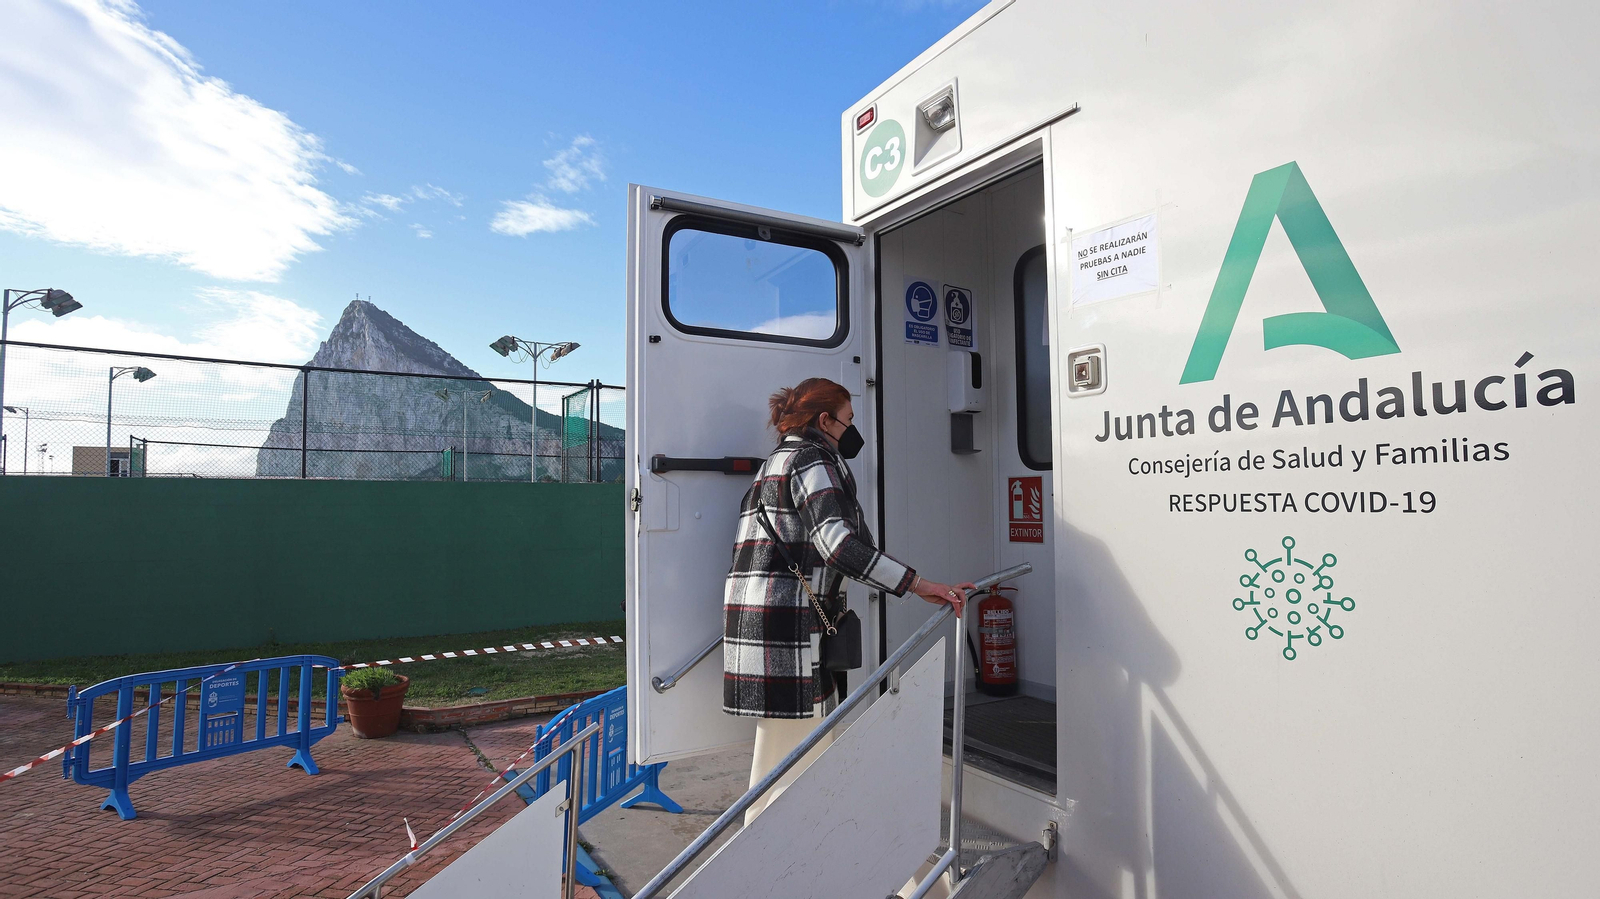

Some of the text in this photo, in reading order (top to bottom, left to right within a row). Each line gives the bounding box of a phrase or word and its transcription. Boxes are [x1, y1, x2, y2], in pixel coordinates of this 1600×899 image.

[864, 136, 901, 180] C3
[1077, 232, 1148, 259] NO SE REALIZARÁN
[1079, 245, 1147, 271] PRUEBAS A NADIE
[1096, 264, 1129, 280] SIN CITA
[1095, 350, 1577, 443] Junta de Andalucía
[1127, 437, 1511, 479] Consejería de Salud y Familias
[1169, 490, 1438, 514] RESPUESTA COVID-19
[1010, 527, 1043, 538] EXTINTOR
[209, 680, 239, 689] DEPORTES
